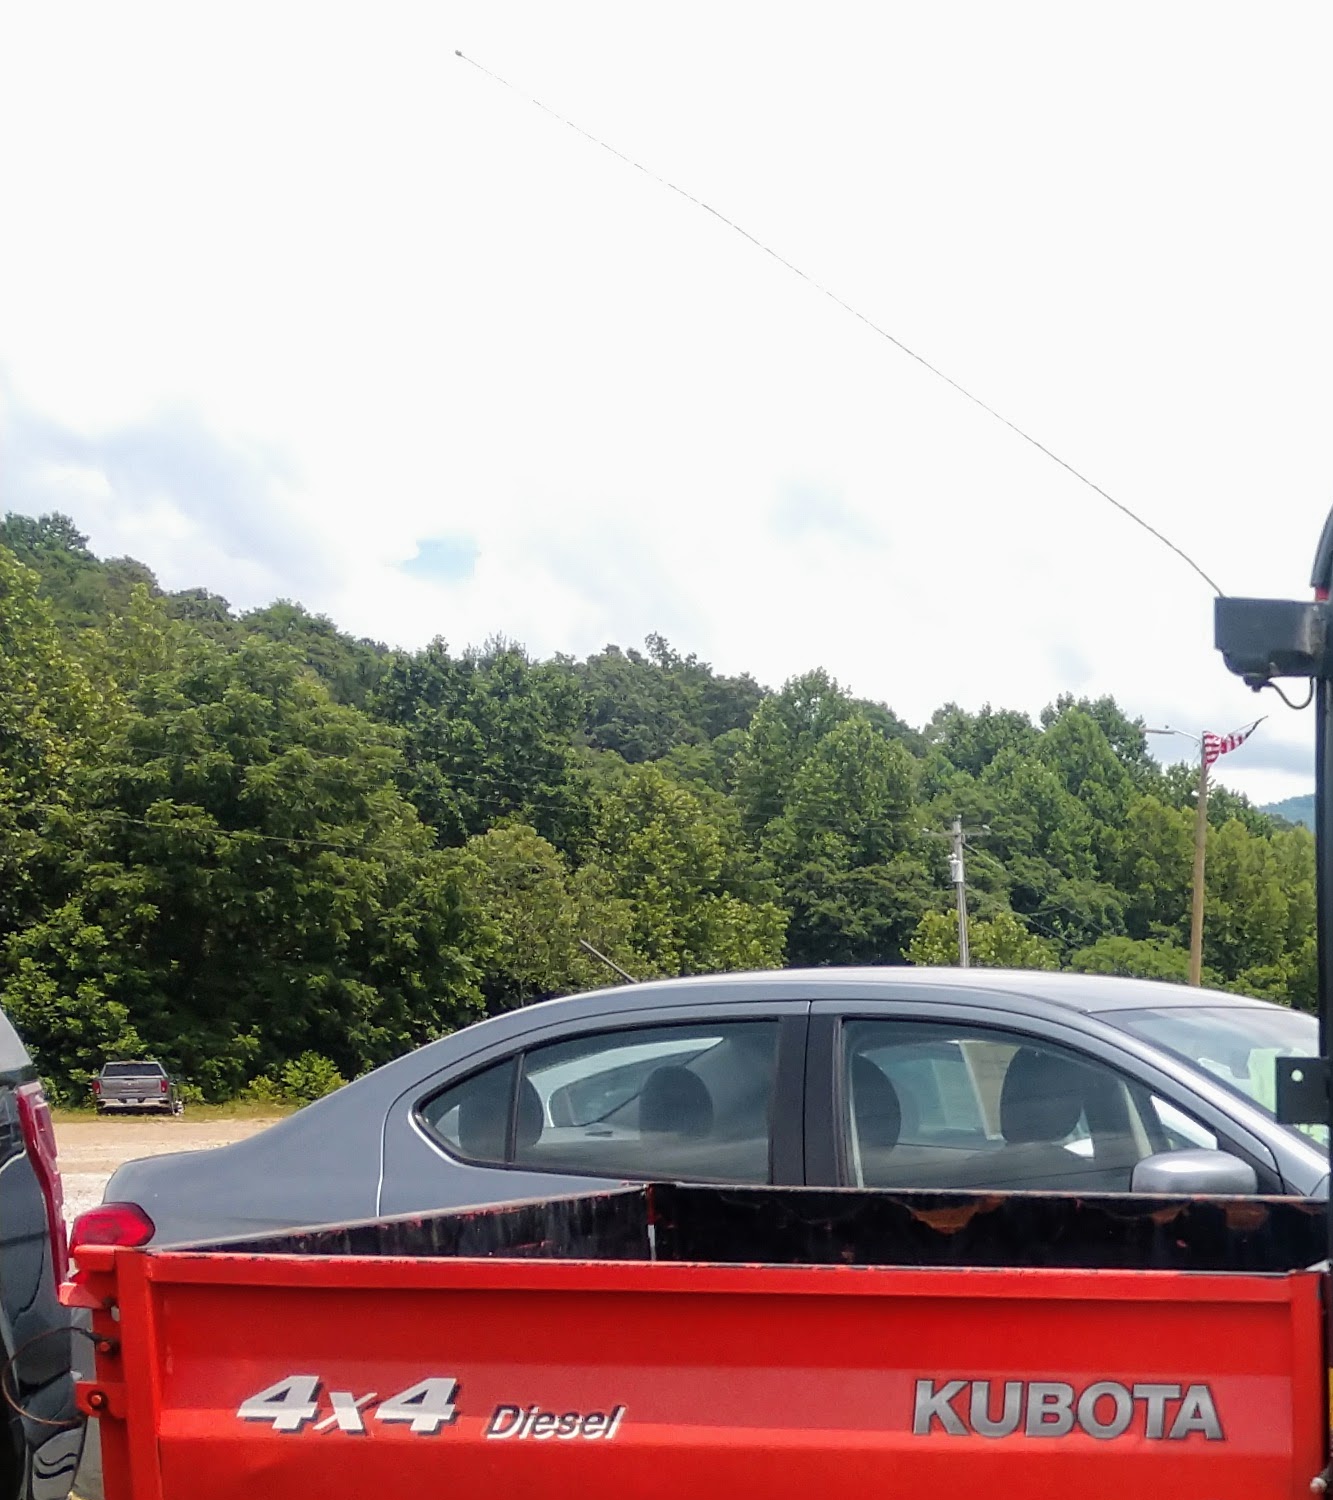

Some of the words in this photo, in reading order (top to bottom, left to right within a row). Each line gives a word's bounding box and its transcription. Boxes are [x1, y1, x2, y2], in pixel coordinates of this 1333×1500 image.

[236, 1375, 461, 1436] 4x4
[485, 1403, 627, 1440] Diesel
[912, 1378, 1226, 1441] KUBOTA
